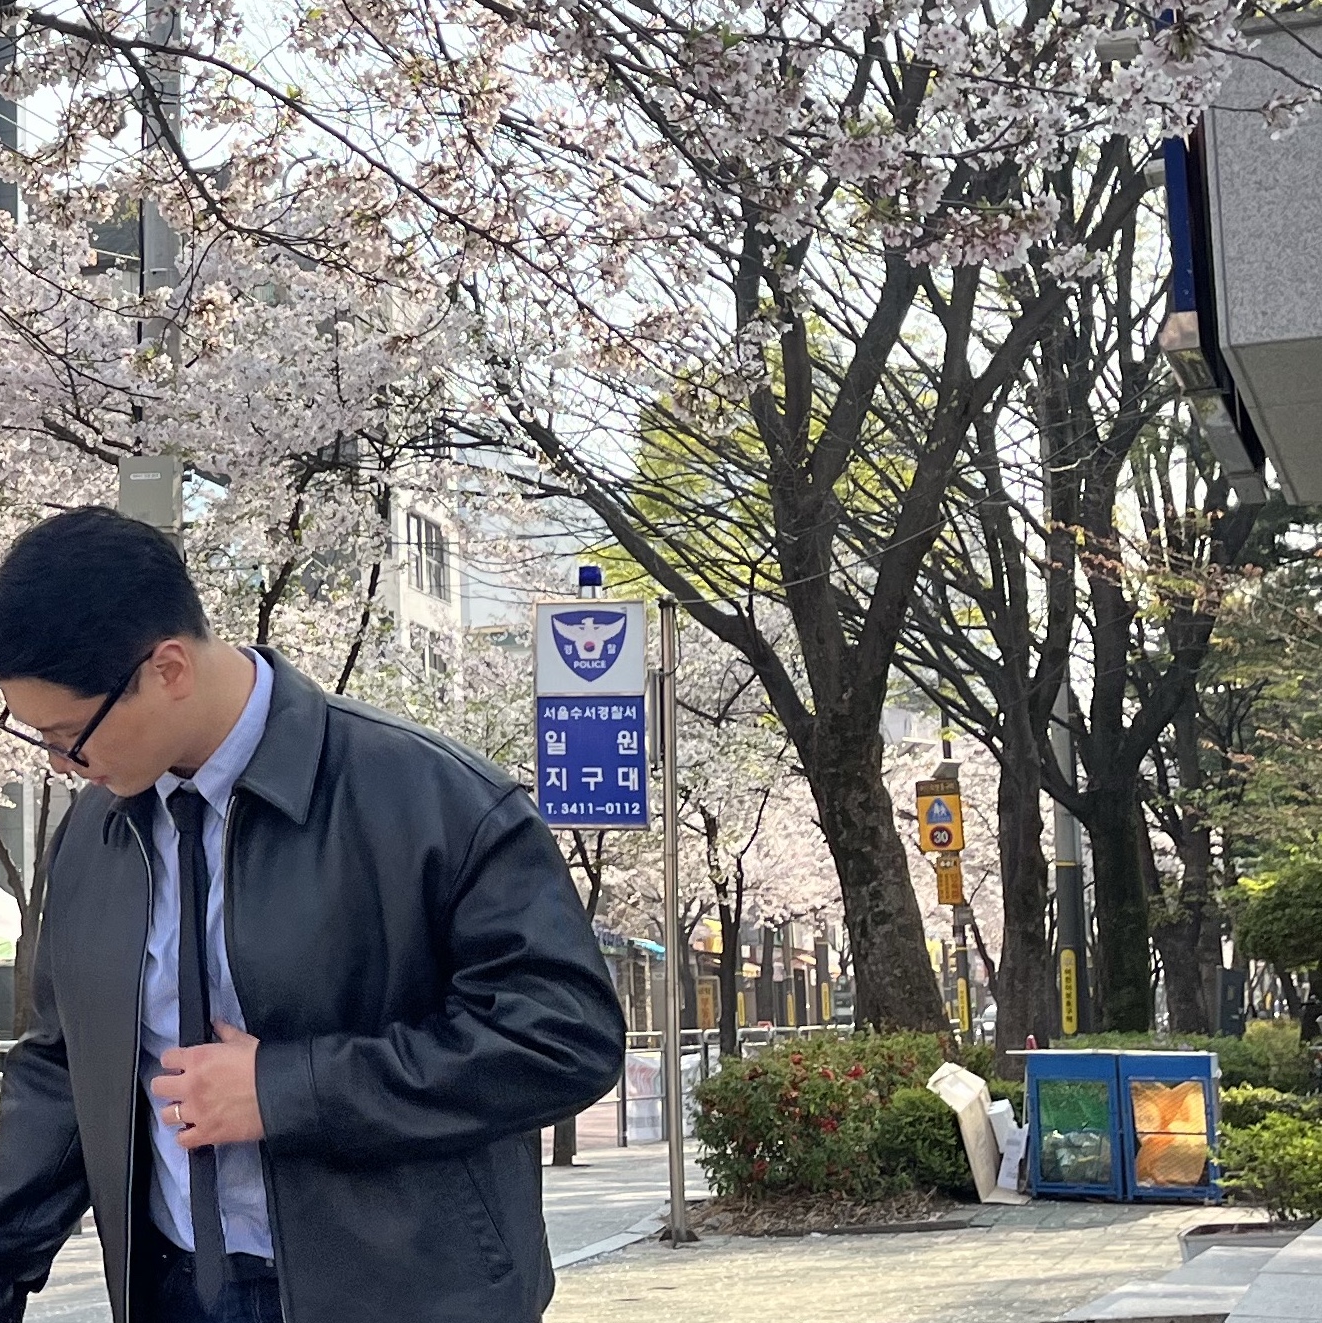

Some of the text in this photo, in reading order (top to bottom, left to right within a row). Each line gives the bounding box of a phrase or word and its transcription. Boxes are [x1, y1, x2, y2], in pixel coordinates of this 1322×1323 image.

[573, 660, 606, 669] POLICE
[543, 705, 637, 720] 서울수서경찰서
[546, 802, 641, 815] T. 3411-0112
[933, 830, 949, 844] 30
